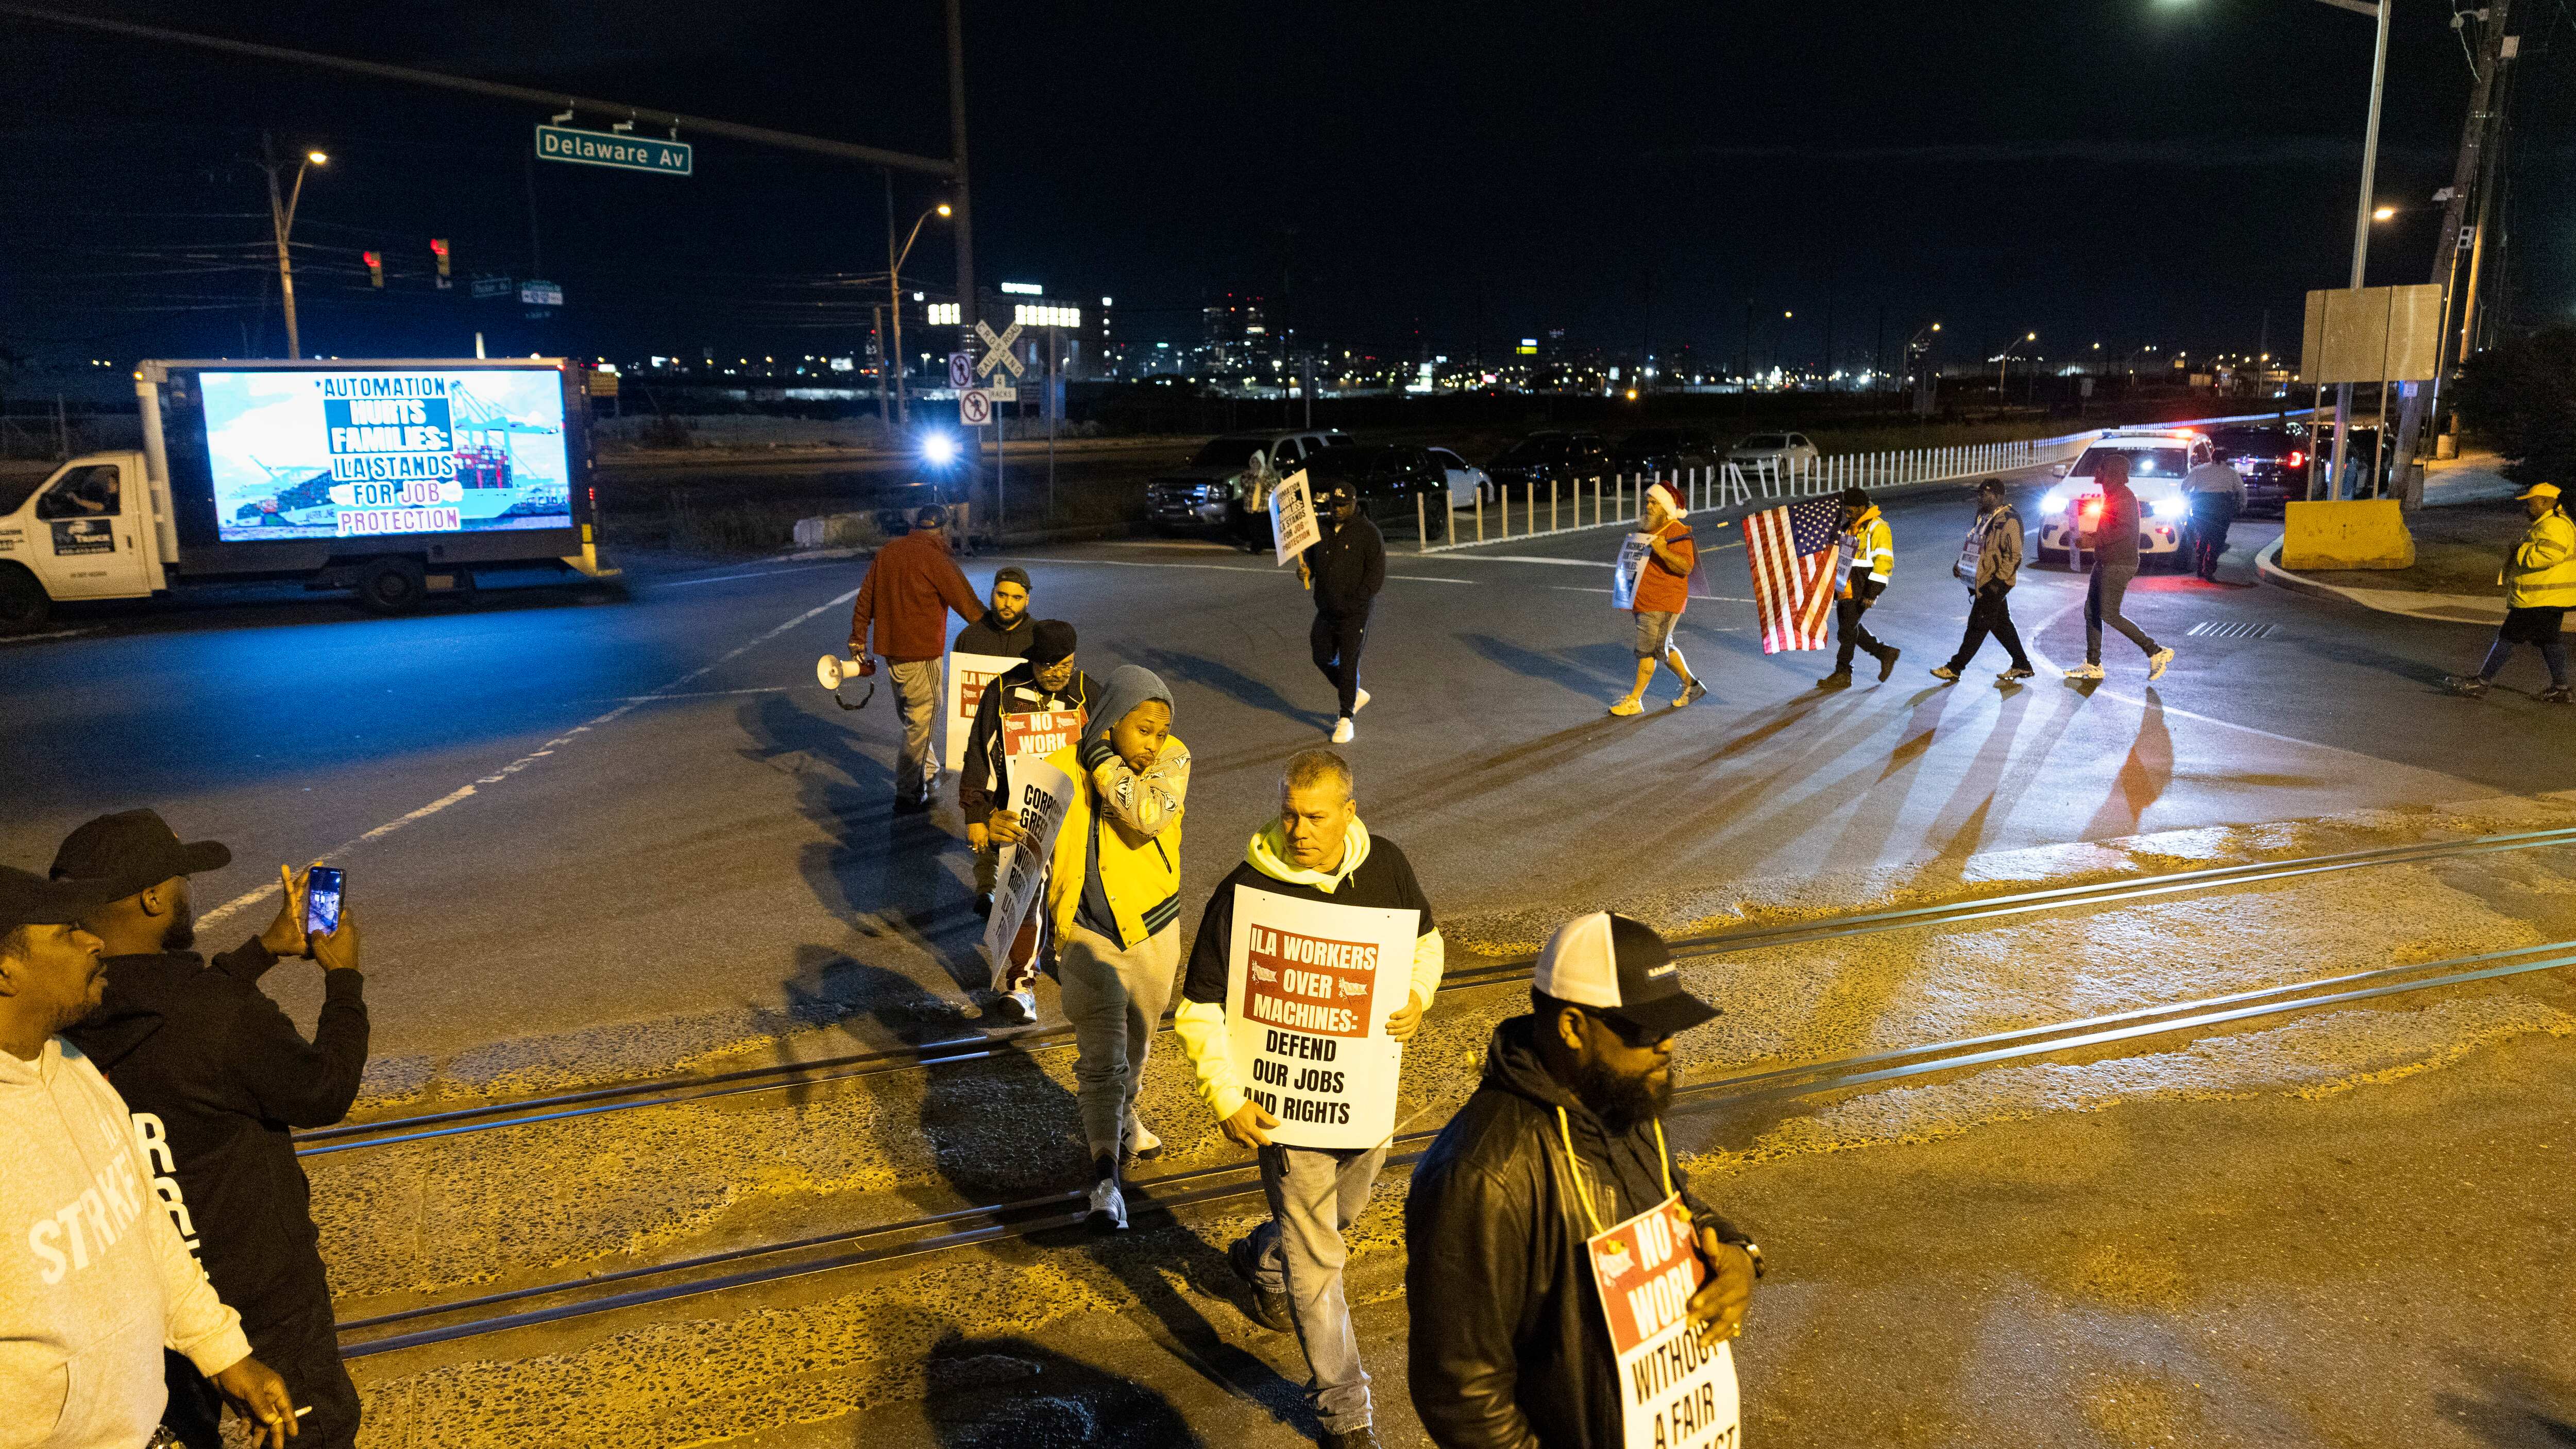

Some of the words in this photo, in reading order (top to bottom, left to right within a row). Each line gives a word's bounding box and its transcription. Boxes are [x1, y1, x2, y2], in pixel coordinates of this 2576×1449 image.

[545, 134, 648, 163] Delaware
[660, 149, 683, 167] Av
[978, 324, 1022, 375] CROSSING
[979, 355, 997, 377] RAIL
[325, 378, 445, 397] AUTOMATION
[991, 390, 1013, 398] RACKS
[349, 399, 427, 425] HURTS
[331, 425, 449, 453] FAMILIES:
[333, 457, 366, 478] ILA
[374, 455, 453, 477] STANDS
[353, 484, 393, 504] FOR
[401, 483, 439, 503] JOB
[341, 509, 458, 532] PROTECTION
[1283, 527, 1293, 541] FOR
[1294, 521, 1304, 534] JOB
[1286, 509, 1306, 528] STANDS
[961, 672, 976, 685] ILA
[1030, 713, 1053, 731] NO
[1018, 732, 1067, 754] WORK
[1020, 807, 1048, 843] GREED
[1250, 927, 1277, 957] ILA
[1283, 935, 1377, 970] WORKERS
[1283, 968, 1333, 999] OVER
[1253, 993, 1359, 1033] MACHINES:
[1265, 1029, 1337, 1062] DEFEND
[1253, 1058, 1289, 1087] OUR
[1294, 1068, 1345, 1094] JOBS
[1282, 1096, 1350, 1124] RIGHTS
[1633, 1211, 1672, 1272] NO
[1627, 1257, 1697, 1340] WORK
[1655, 1413, 1666, 1449] A
[1672, 1382, 1715, 1445] FAIR
